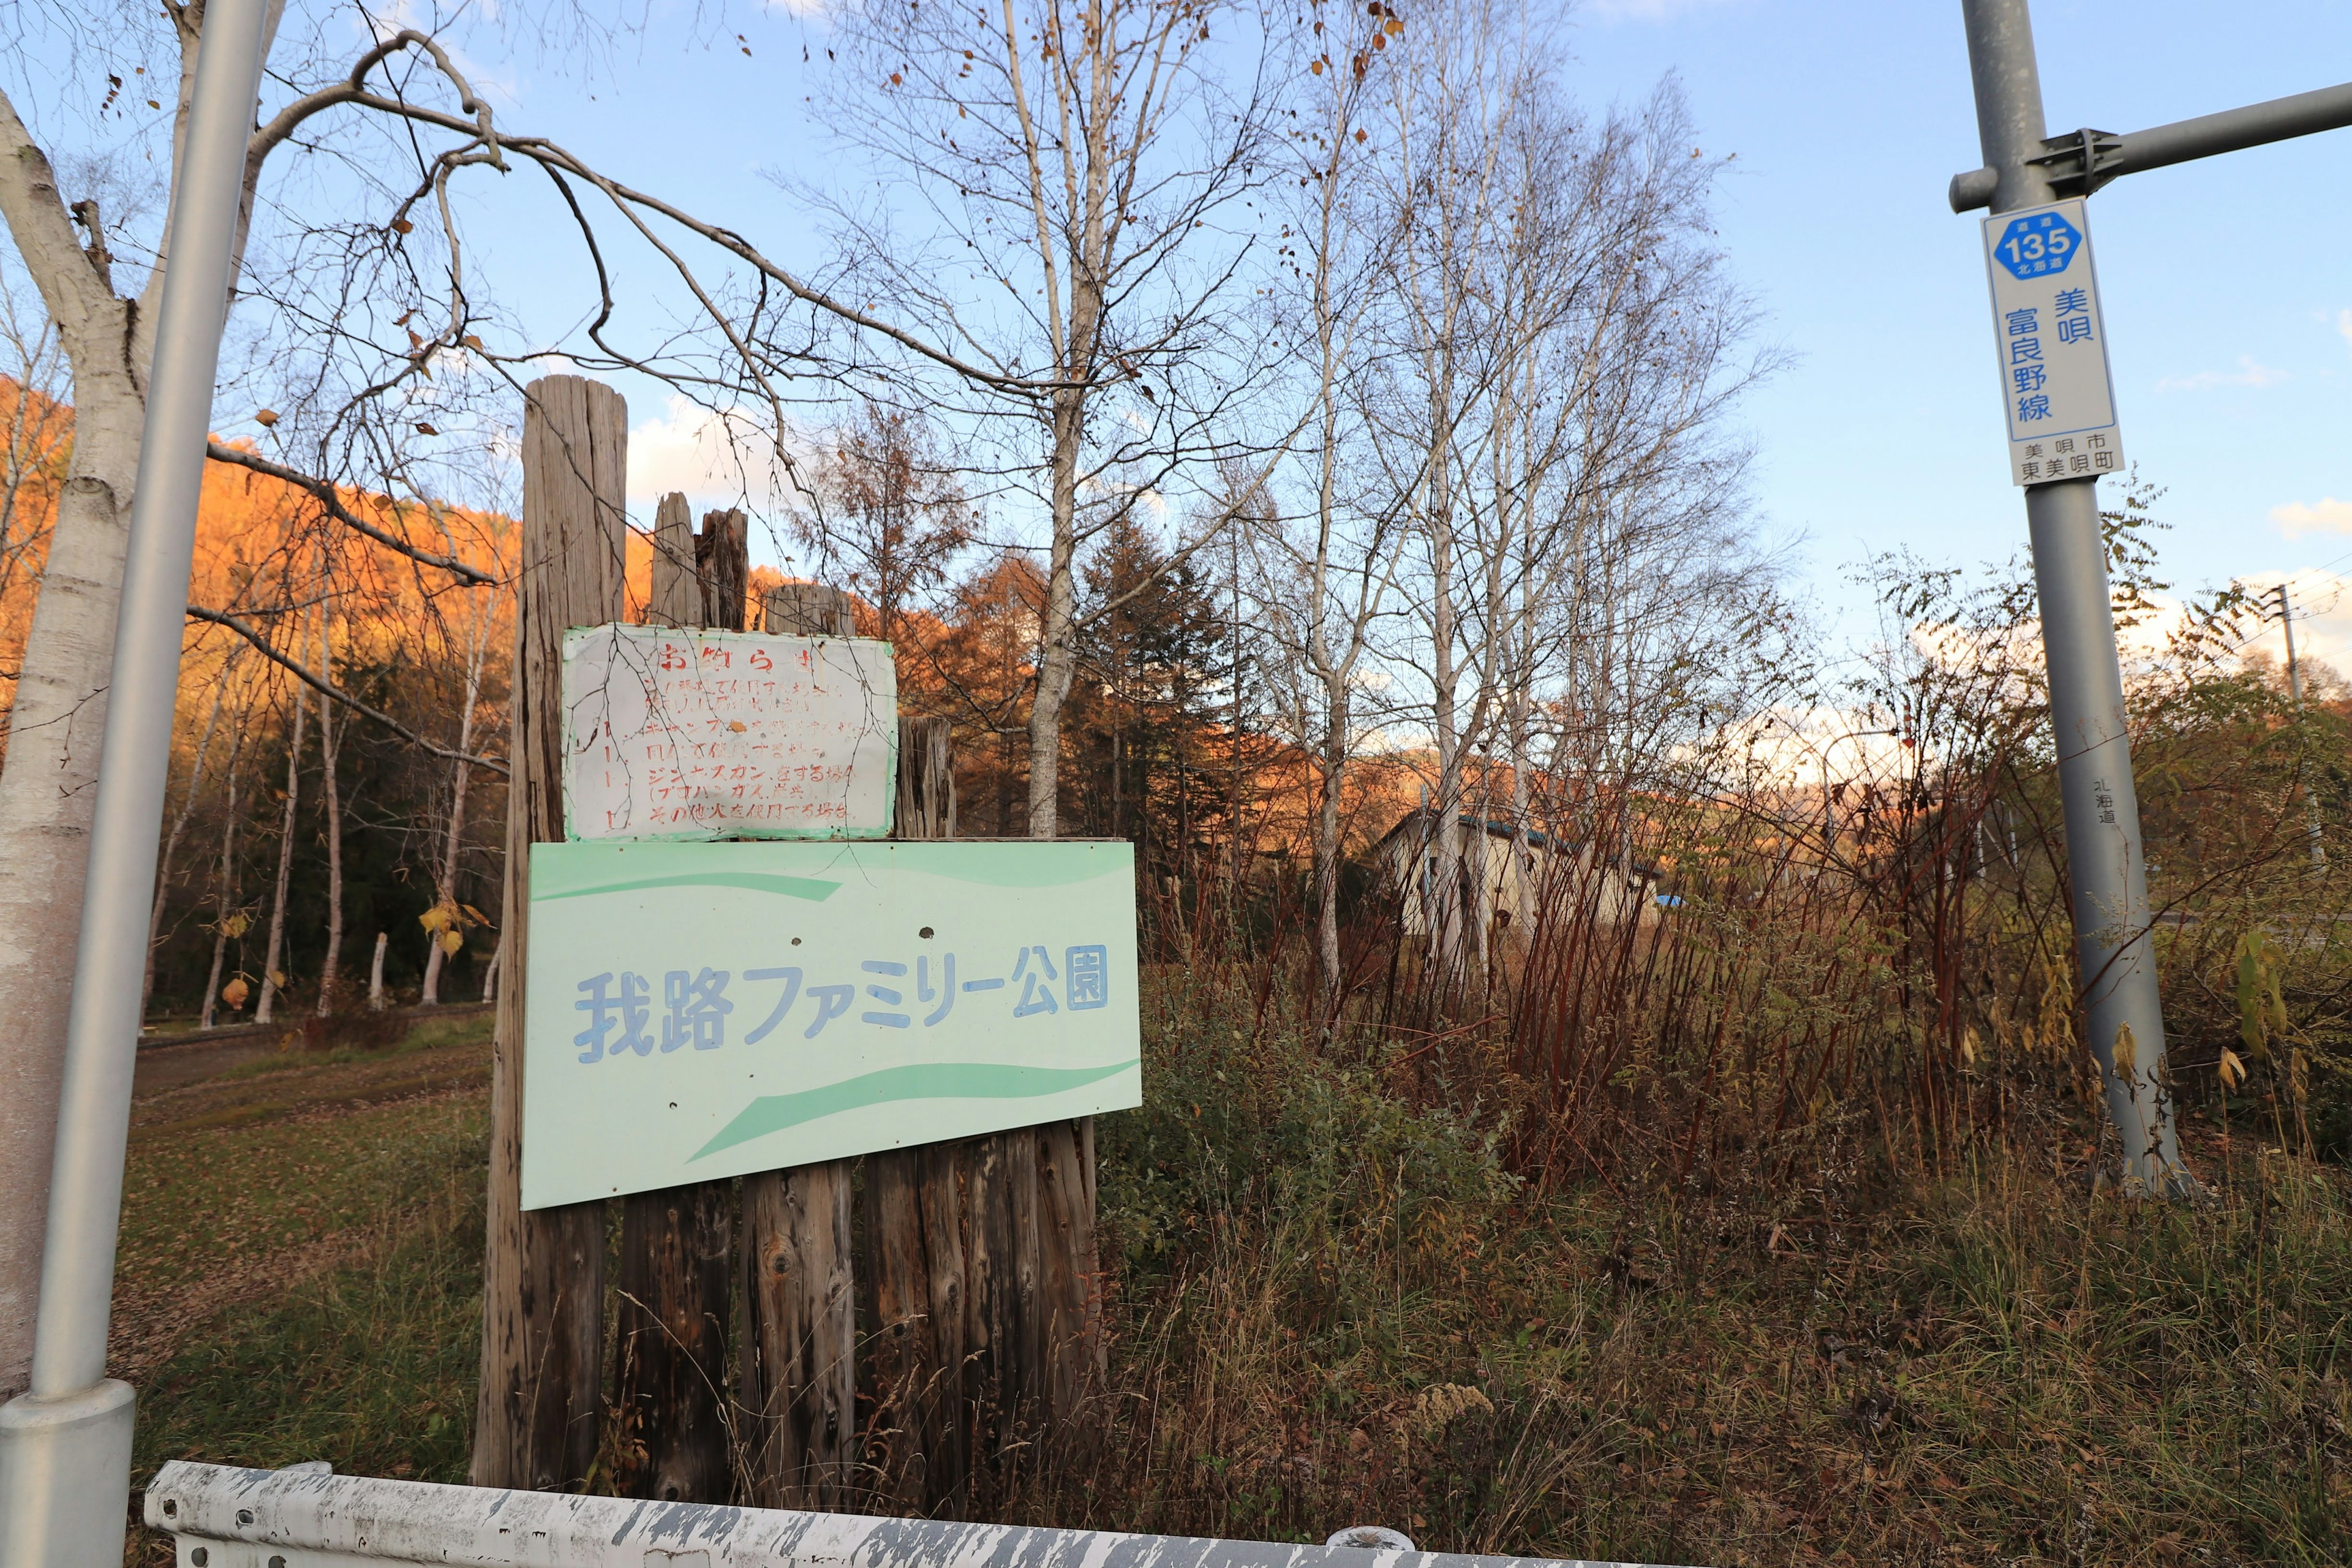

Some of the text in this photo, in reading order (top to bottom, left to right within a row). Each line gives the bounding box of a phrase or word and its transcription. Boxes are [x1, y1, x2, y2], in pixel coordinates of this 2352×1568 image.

[2017, 217, 2052, 233] 道道
[2005, 228, 2071, 263] 135
[2018, 257, 2062, 275] 北海道
[2055, 287, 2094, 344] 美唄
[2006, 308, 2052, 423] 富良野線
[2025, 434, 2105, 459] 美唄市
[2022, 451, 2113, 481] 東美唄町
[658, 644, 815, 673] お知らせ
[2094, 778, 2115, 824] 北海道
[573, 943, 1108, 1063] 我路ファミリー公園
